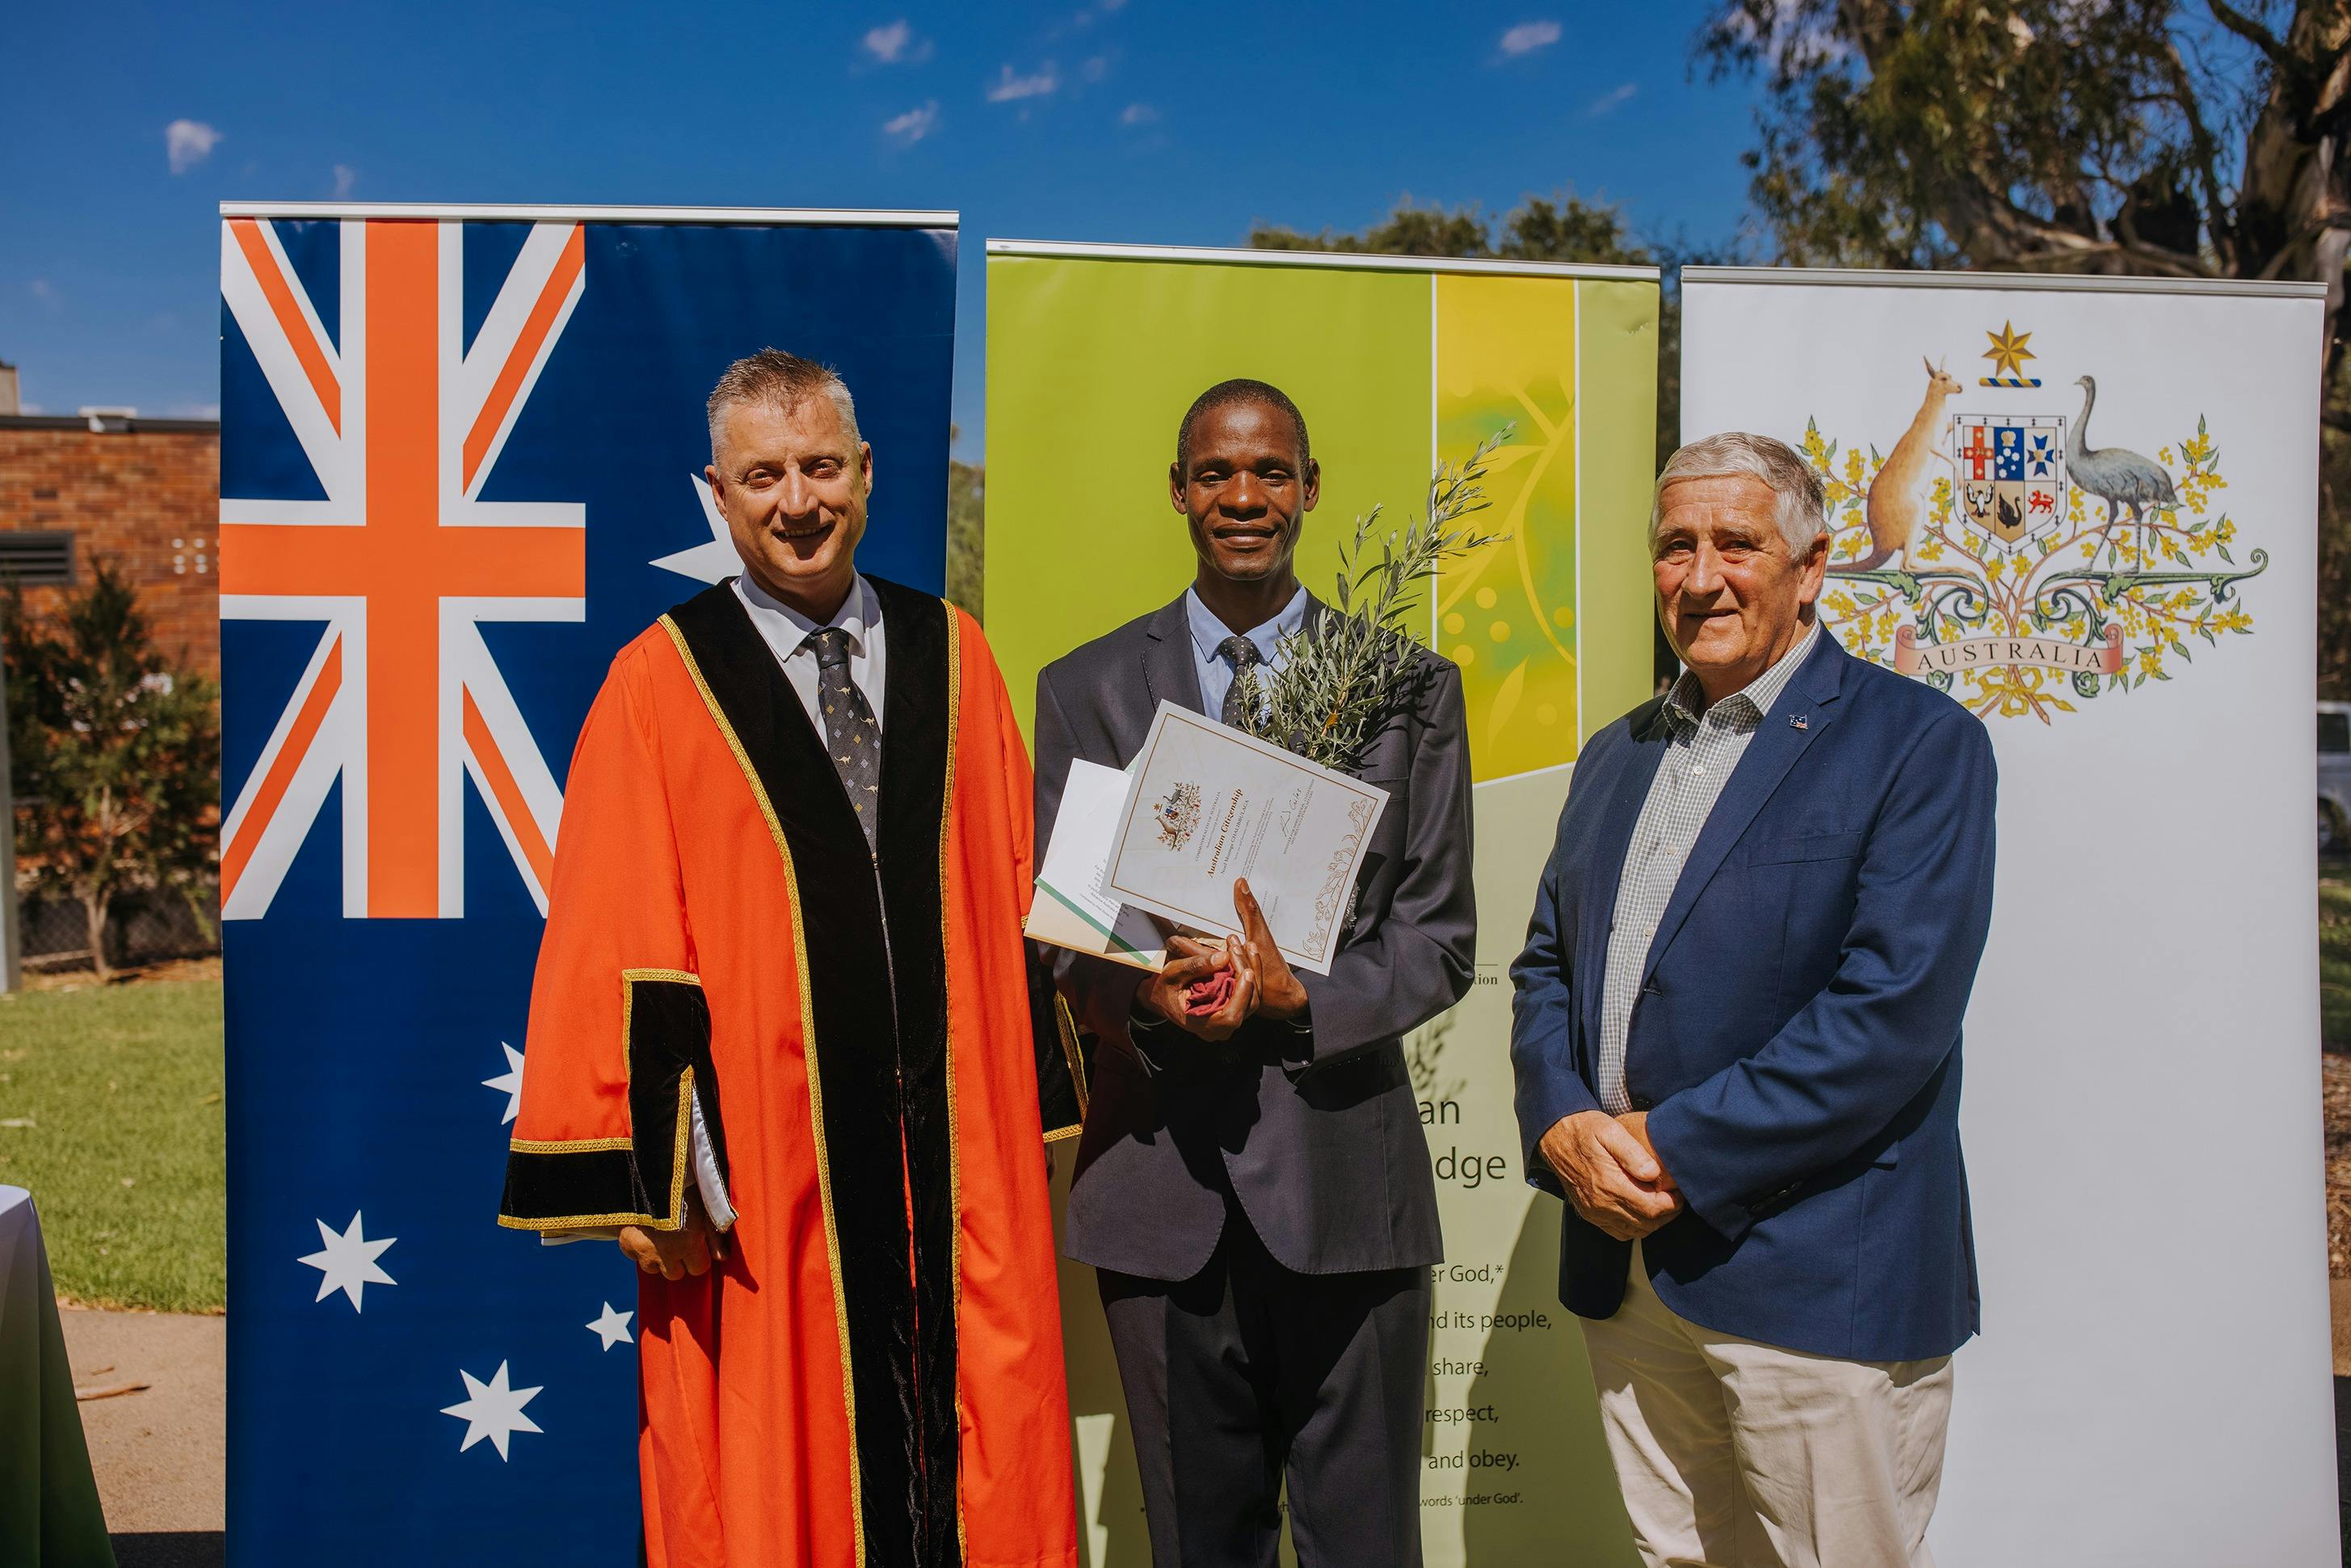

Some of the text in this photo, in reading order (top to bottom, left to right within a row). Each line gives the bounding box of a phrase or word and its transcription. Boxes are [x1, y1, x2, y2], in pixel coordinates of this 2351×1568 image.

[1917, 642, 2102, 670] AUSTRALIA
[1207, 834, 1226, 878] Australian
[1220, 788, 1244, 833] Citizenship
[1419, 1100, 1460, 1125] an
[1435, 1146, 1506, 1188] dge
[1454, 1311, 1474, 1329] its
[1481, 1309, 1552, 1333] people,
[1432, 1357, 1489, 1377] share,
[1425, 1405, 1499, 1426] respect,
[1428, 1449, 1520, 1472] and obey.
[1419, 1495, 1453, 1507] words
